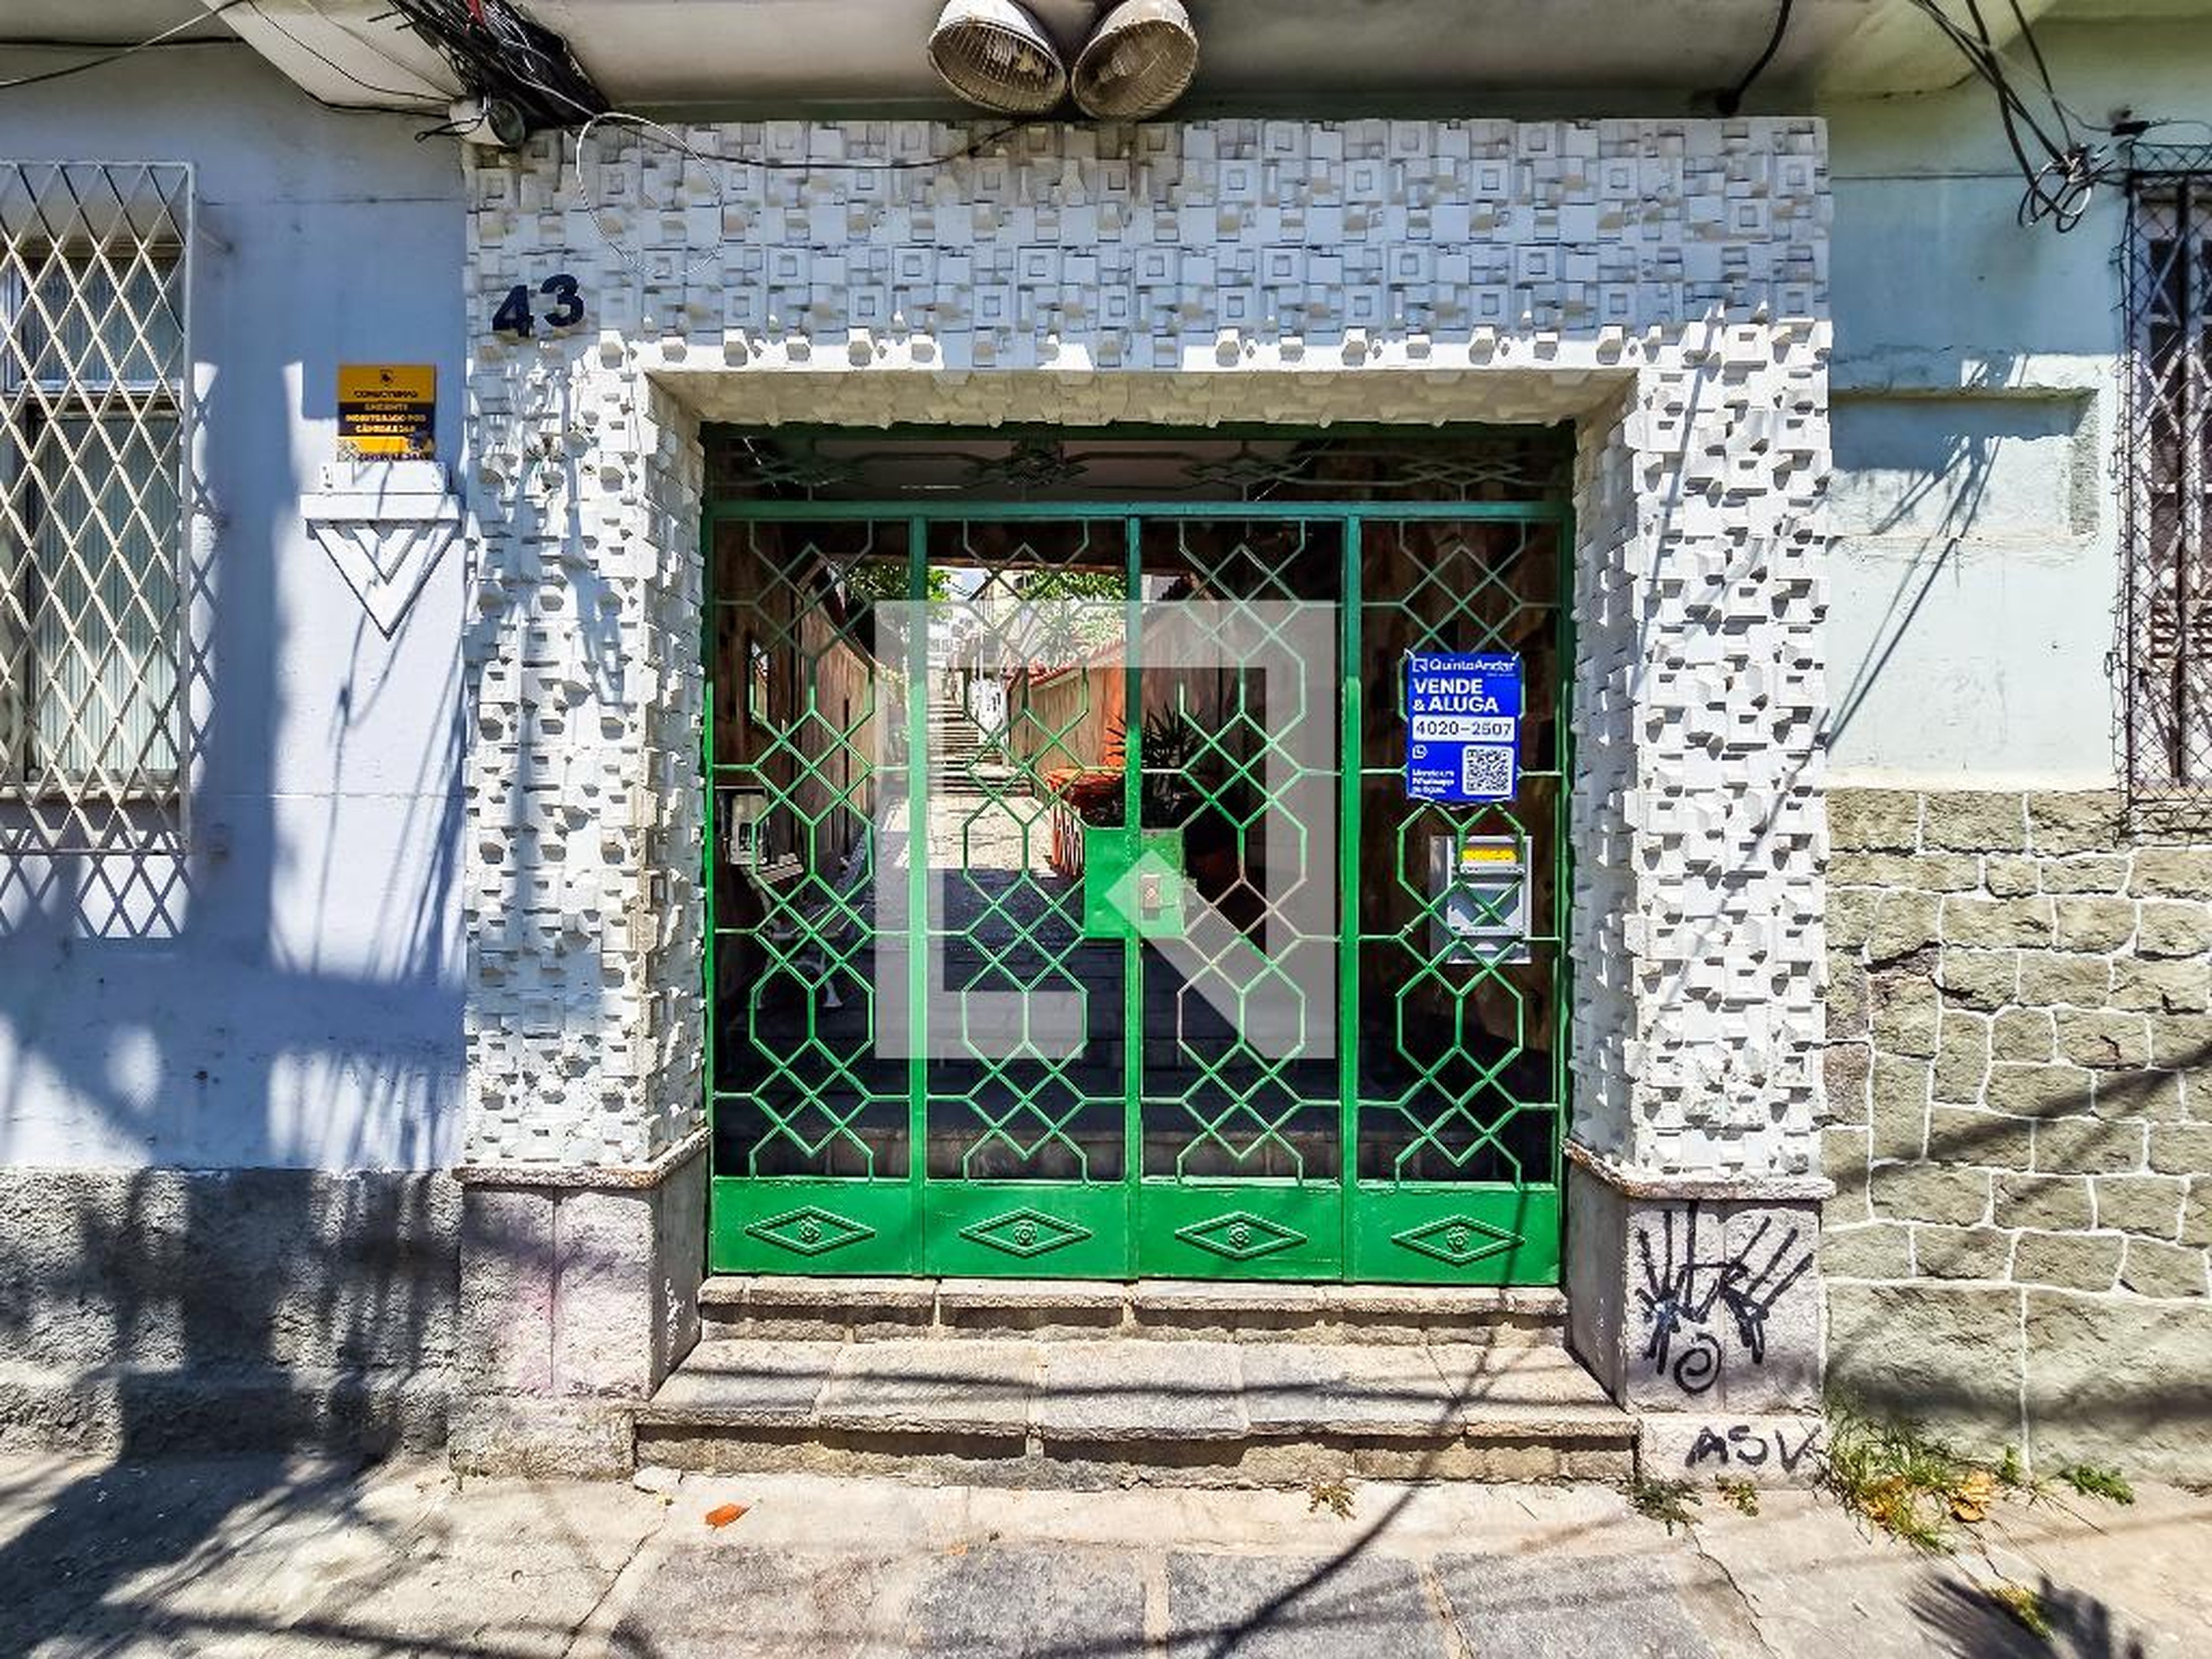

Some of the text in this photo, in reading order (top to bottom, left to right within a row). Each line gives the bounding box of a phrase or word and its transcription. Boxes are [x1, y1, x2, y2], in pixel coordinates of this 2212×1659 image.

[492, 273, 584, 338] 43
[1429, 658, 1515, 672] QuintoAndar
[1413, 678, 1483, 694] VENDE
[1413, 696, 1499, 713] & ALUGA
[1416, 720, 1512, 736] 4020-2507
